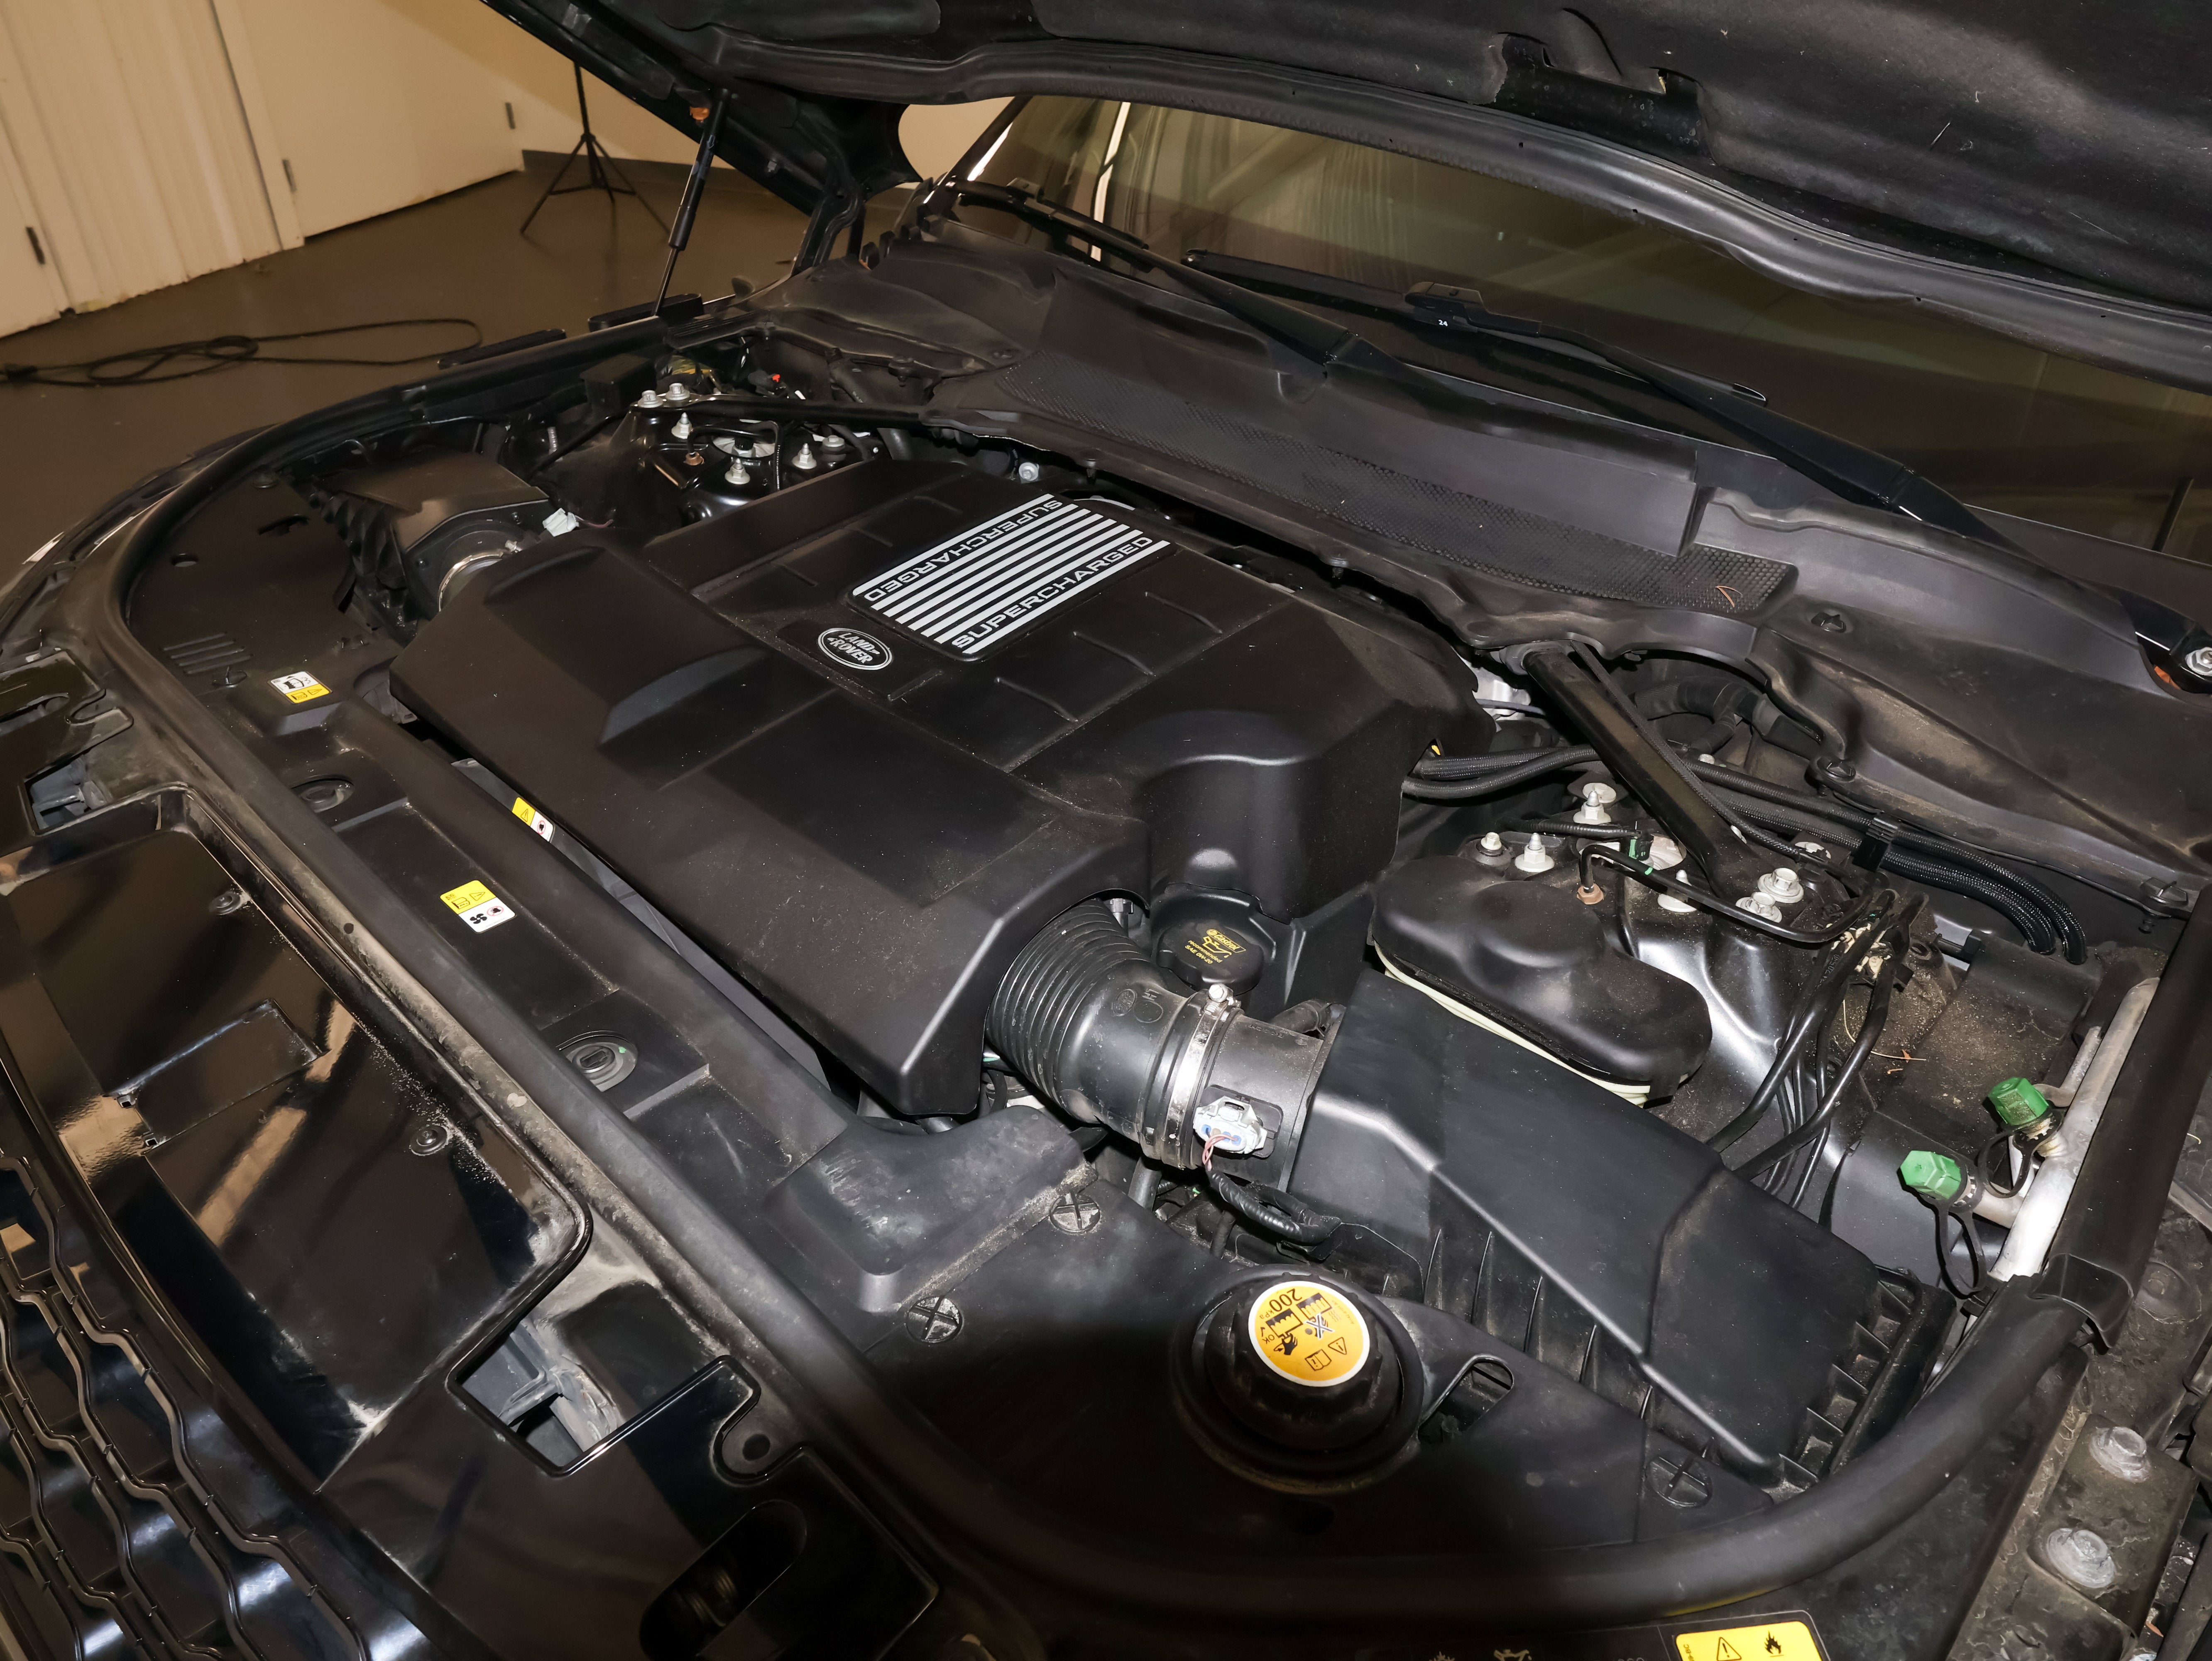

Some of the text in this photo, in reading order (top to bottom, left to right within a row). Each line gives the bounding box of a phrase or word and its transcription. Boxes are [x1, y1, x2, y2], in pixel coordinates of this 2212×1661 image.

[864, 500, 1063, 602] SUPERCHARGED
[952, 537, 1153, 648] SUPERCHARGED
[830, 639, 873, 664] ROVER
[838, 632, 875, 651] LAND
[1188, 940, 1223, 963] recommended
[1214, 934, 1240, 951] Castrol
[1185, 945, 1213, 964] SAE 0W-20
[1259, 1288, 1302, 1319] 200 kPa
[1262, 1334, 1275, 1345] OK
